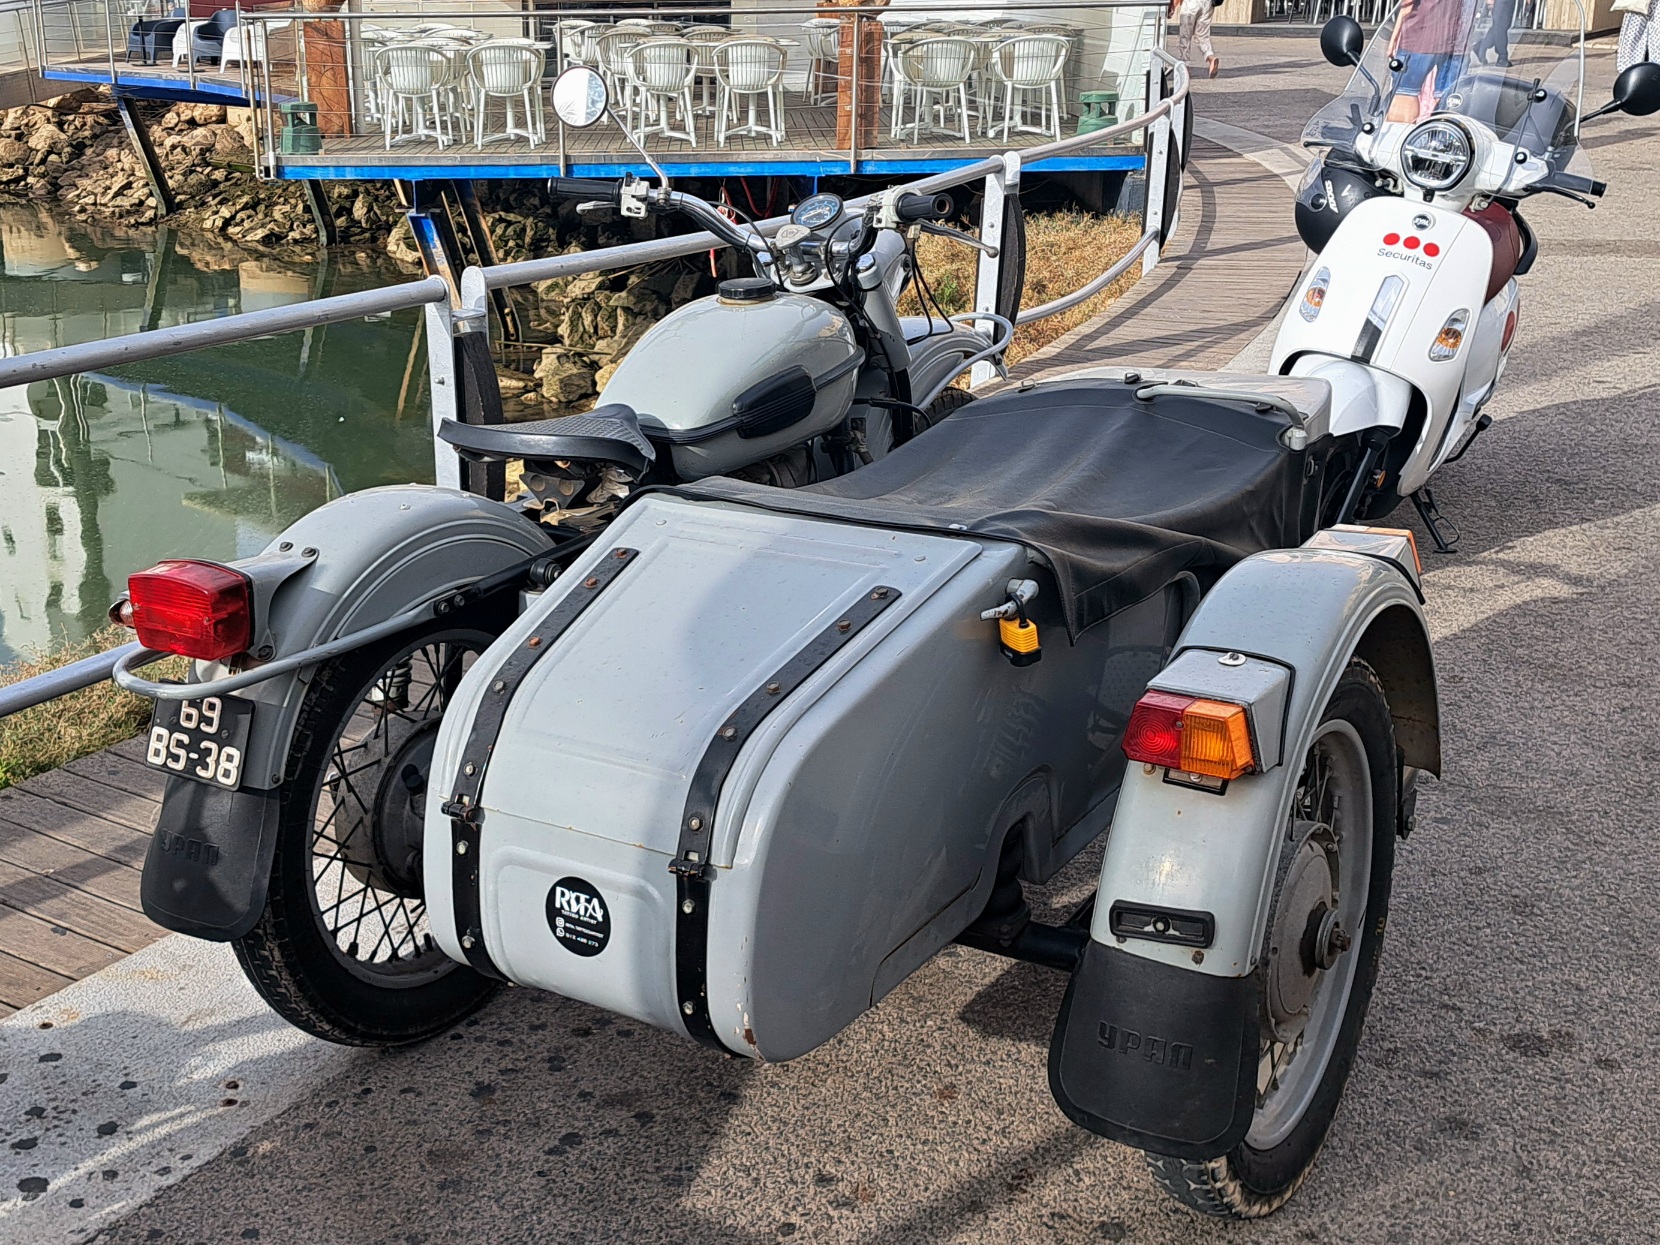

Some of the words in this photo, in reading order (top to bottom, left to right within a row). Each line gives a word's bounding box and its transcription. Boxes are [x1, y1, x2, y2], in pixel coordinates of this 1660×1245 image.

[1377, 247, 1434, 270] Securitas
[180, 696, 222, 734] 69
[147, 725, 241, 786] BS-38
[1097, 1019, 1193, 1070] УРАЛ
